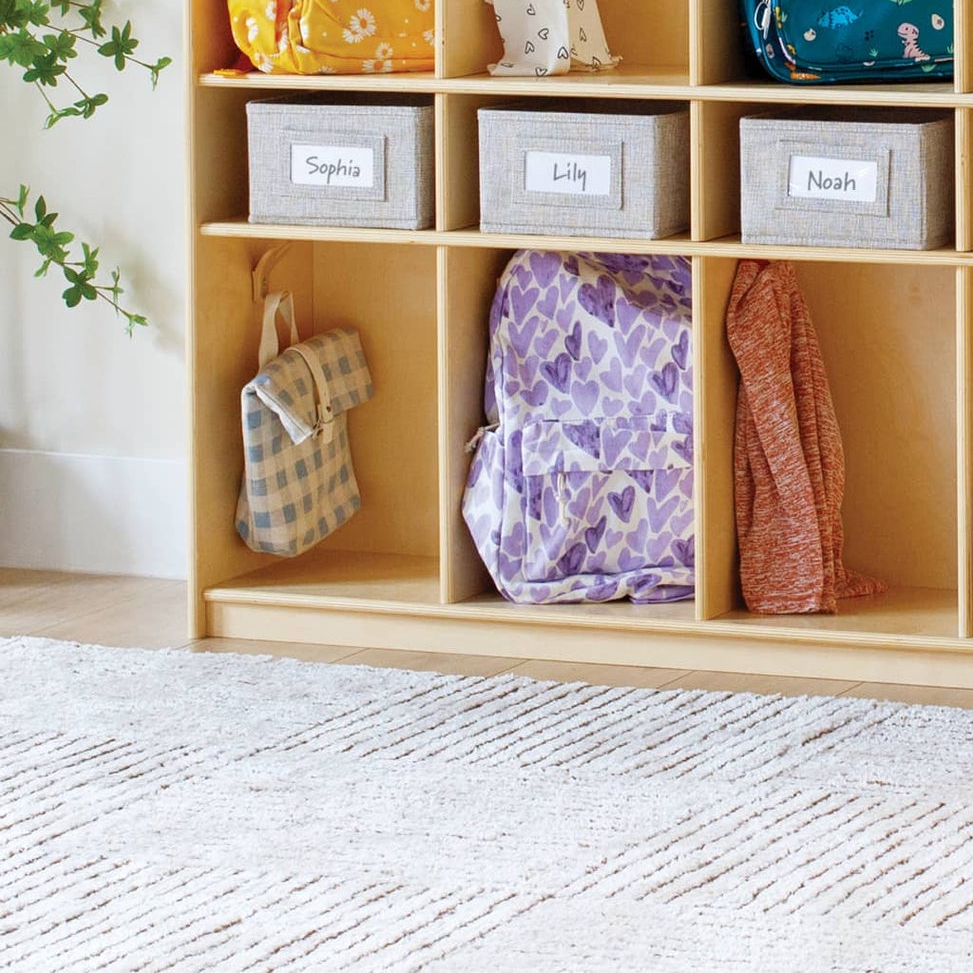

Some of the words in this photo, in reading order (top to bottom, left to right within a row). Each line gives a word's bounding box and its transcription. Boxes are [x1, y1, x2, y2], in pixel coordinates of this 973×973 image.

[305, 156, 361, 184] Sophia
[553, 162, 587, 192] Lily
[807, 170, 856, 192] Noah
